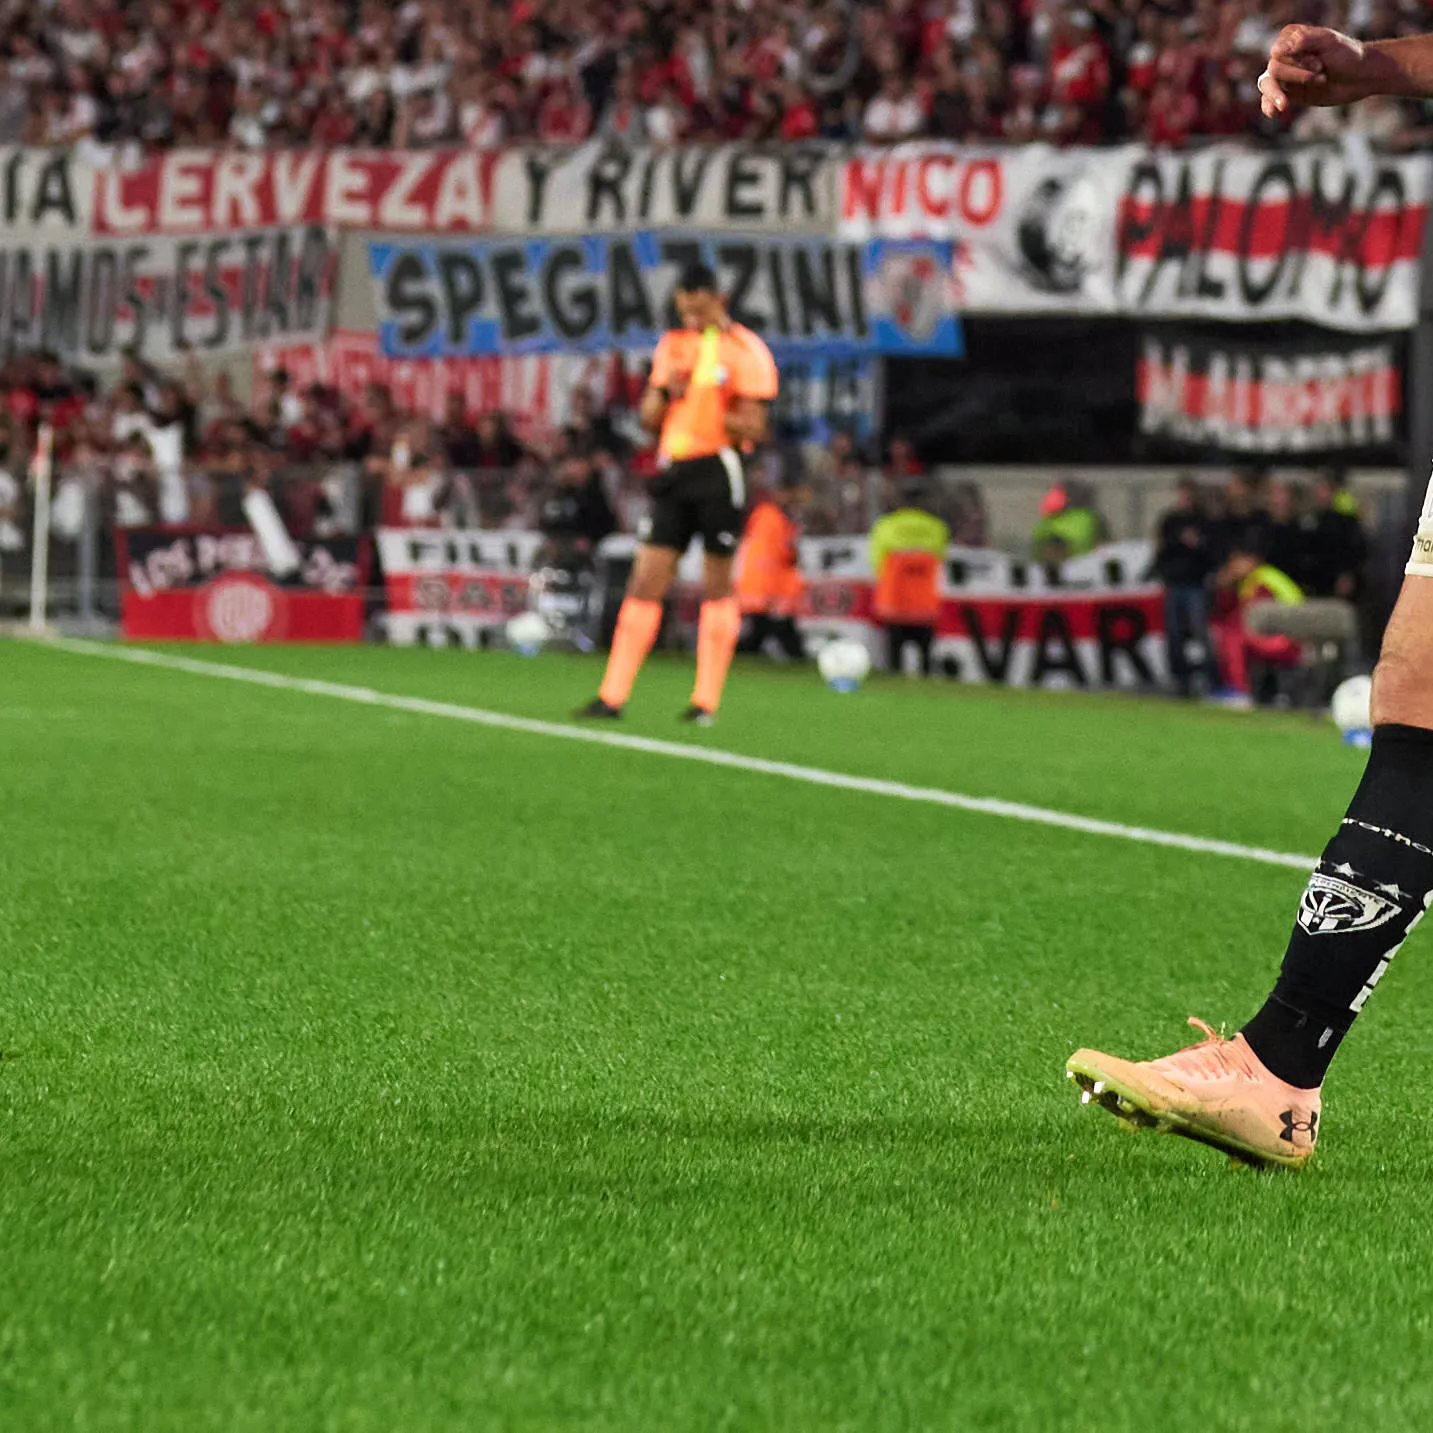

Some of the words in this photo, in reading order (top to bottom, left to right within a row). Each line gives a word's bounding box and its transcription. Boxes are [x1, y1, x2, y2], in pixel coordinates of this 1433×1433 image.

[103, 149, 488, 230] CERVEZA
[525, 156, 550, 225] Y
[584, 141, 821, 225] RIVER
[842, 156, 1005, 226] NICO
